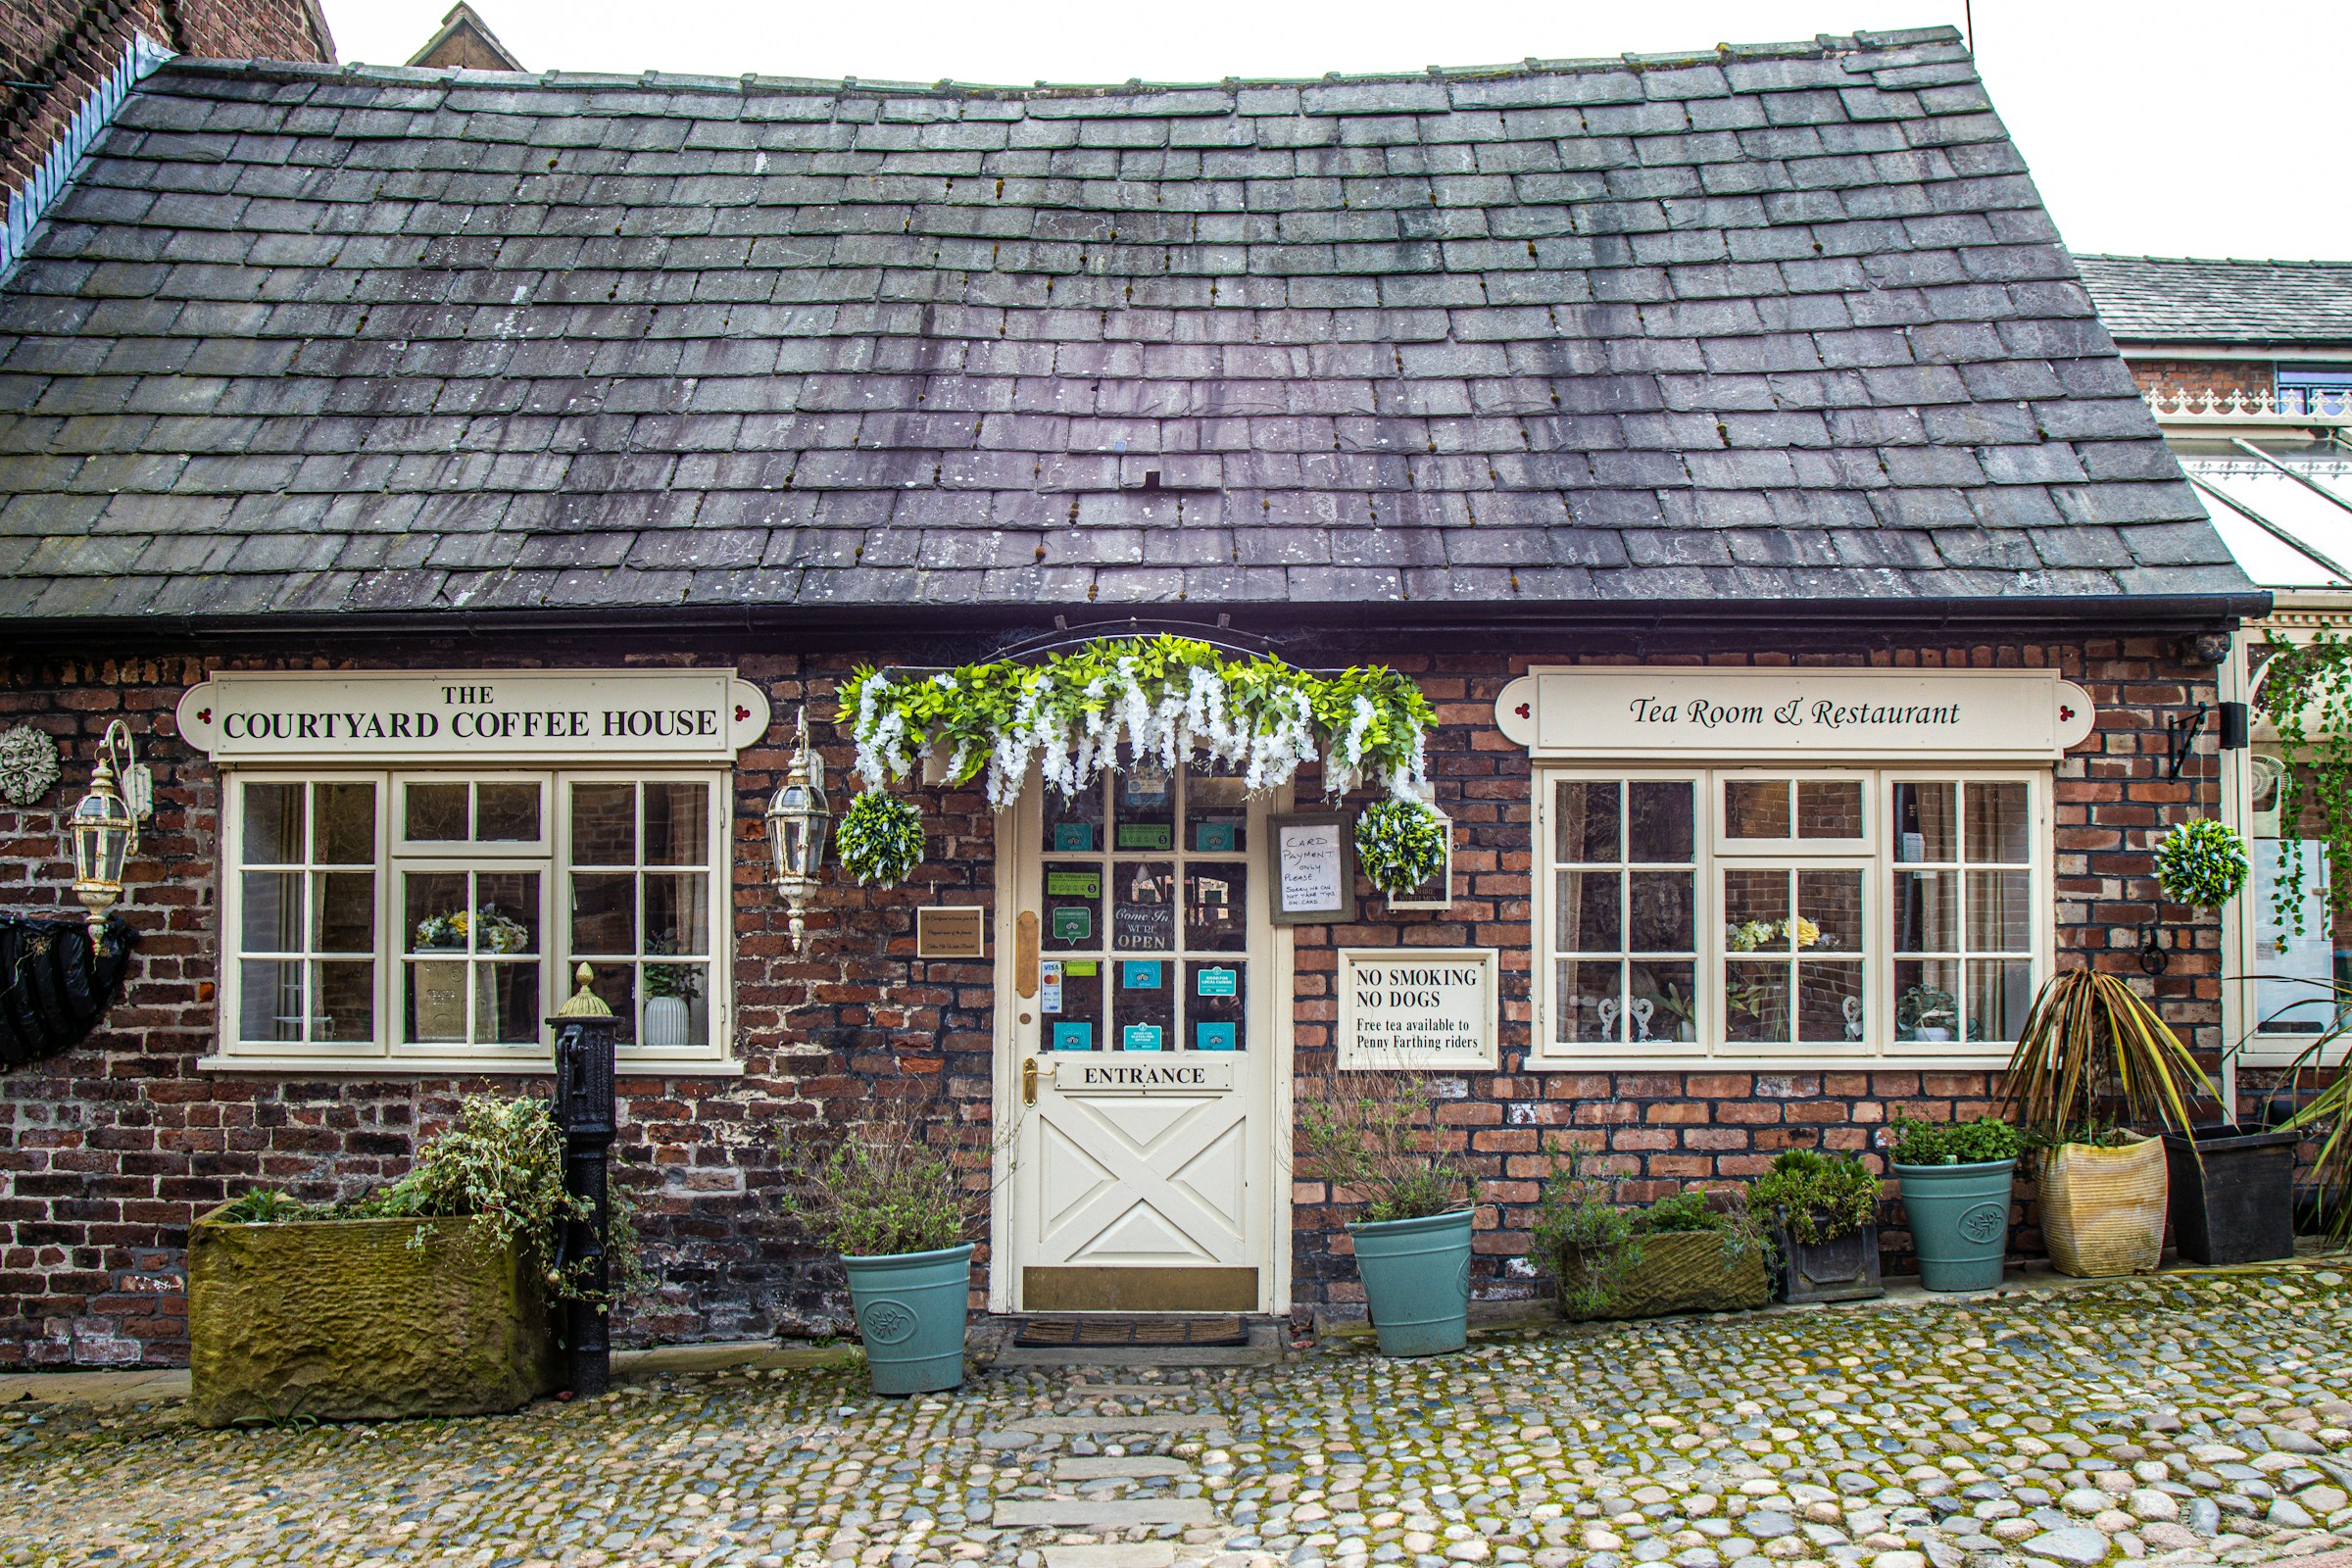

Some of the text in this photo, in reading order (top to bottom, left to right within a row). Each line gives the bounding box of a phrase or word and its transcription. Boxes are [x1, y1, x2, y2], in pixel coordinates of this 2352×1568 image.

[442, 686, 493, 704] THE
[1631, 697, 1960, 729] Tea Room & Restaurant
[224, 710, 716, 738] COURTYARD COFFEE HOUSE
[1286, 837, 1328, 848] CARD
[1298, 864, 1321, 873] ONLY
[1115, 907, 1169, 922] Come In
[1118, 934, 1165, 949] OPEN
[1357, 969, 1477, 986] NO SMOKING
[1357, 991, 1441, 1007] NO DOGS
[1357, 1018, 1469, 1031] Free tea available to
[1357, 1035, 1478, 1052] Penny Farthing riders
[1085, 1067, 1205, 1084] ENTRANCE
